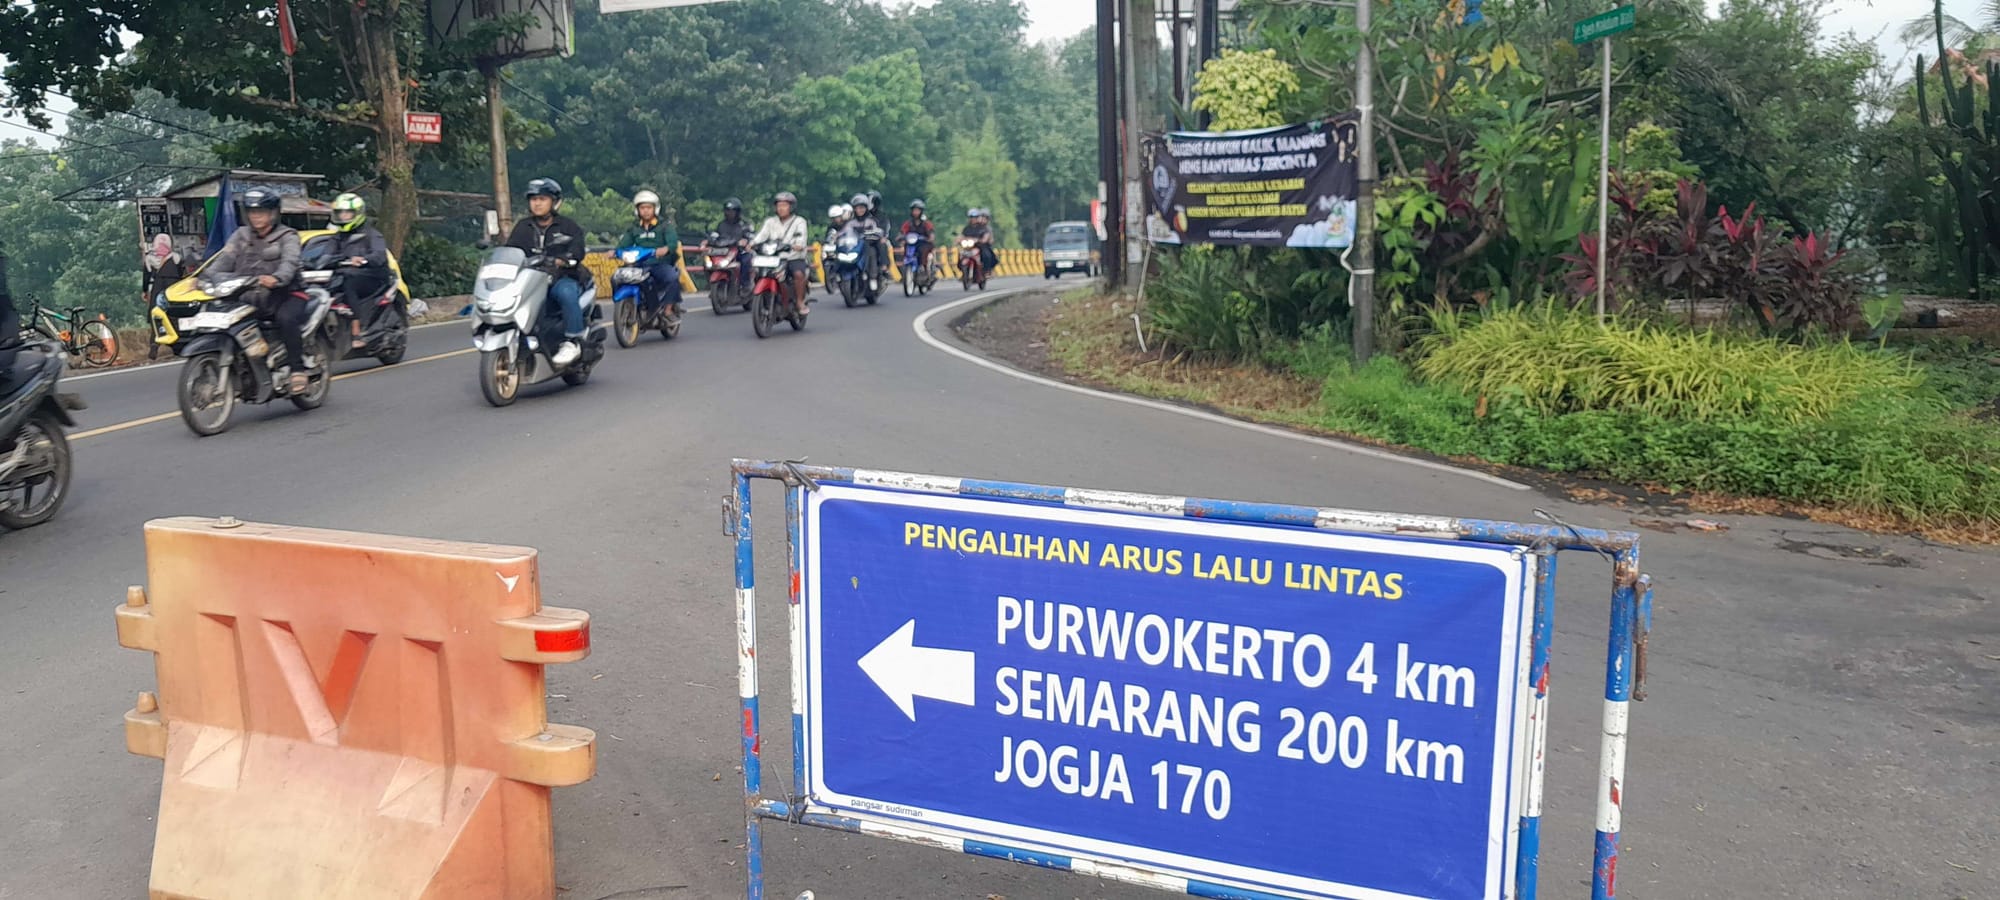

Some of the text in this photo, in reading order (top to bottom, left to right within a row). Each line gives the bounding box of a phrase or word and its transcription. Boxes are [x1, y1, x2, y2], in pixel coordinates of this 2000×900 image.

[1201, 154, 1261, 174] BANYUMAS
[904, 522, 1404, 600] PENGALIHAN ARUS LALU LINTAS
[997, 596, 1476, 708] PURWOKERTO 4 km
[995, 666, 1464, 784] SEMARANG 200 km
[850, 799, 923, 817] pangsar sudirman
[994, 736, 1231, 820] JOGJA 170
